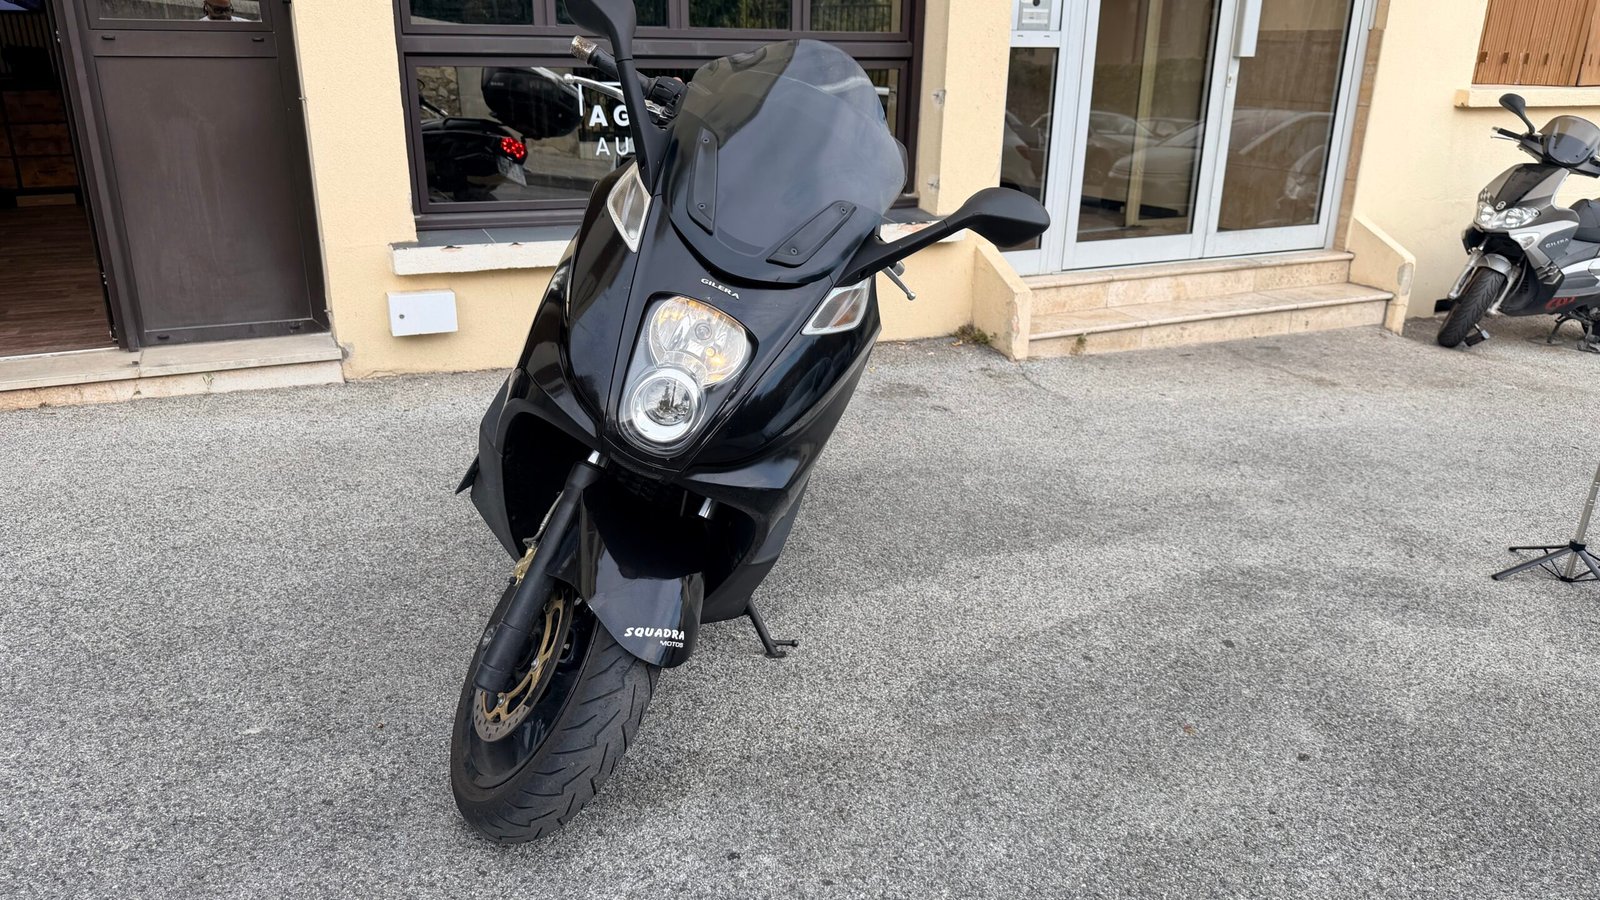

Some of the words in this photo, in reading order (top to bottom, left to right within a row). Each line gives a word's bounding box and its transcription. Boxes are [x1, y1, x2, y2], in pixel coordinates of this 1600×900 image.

[700, 278, 740, 300] GILERA
[624, 627, 685, 640] SQUADRA
[660, 640, 684, 648] MOTOS
